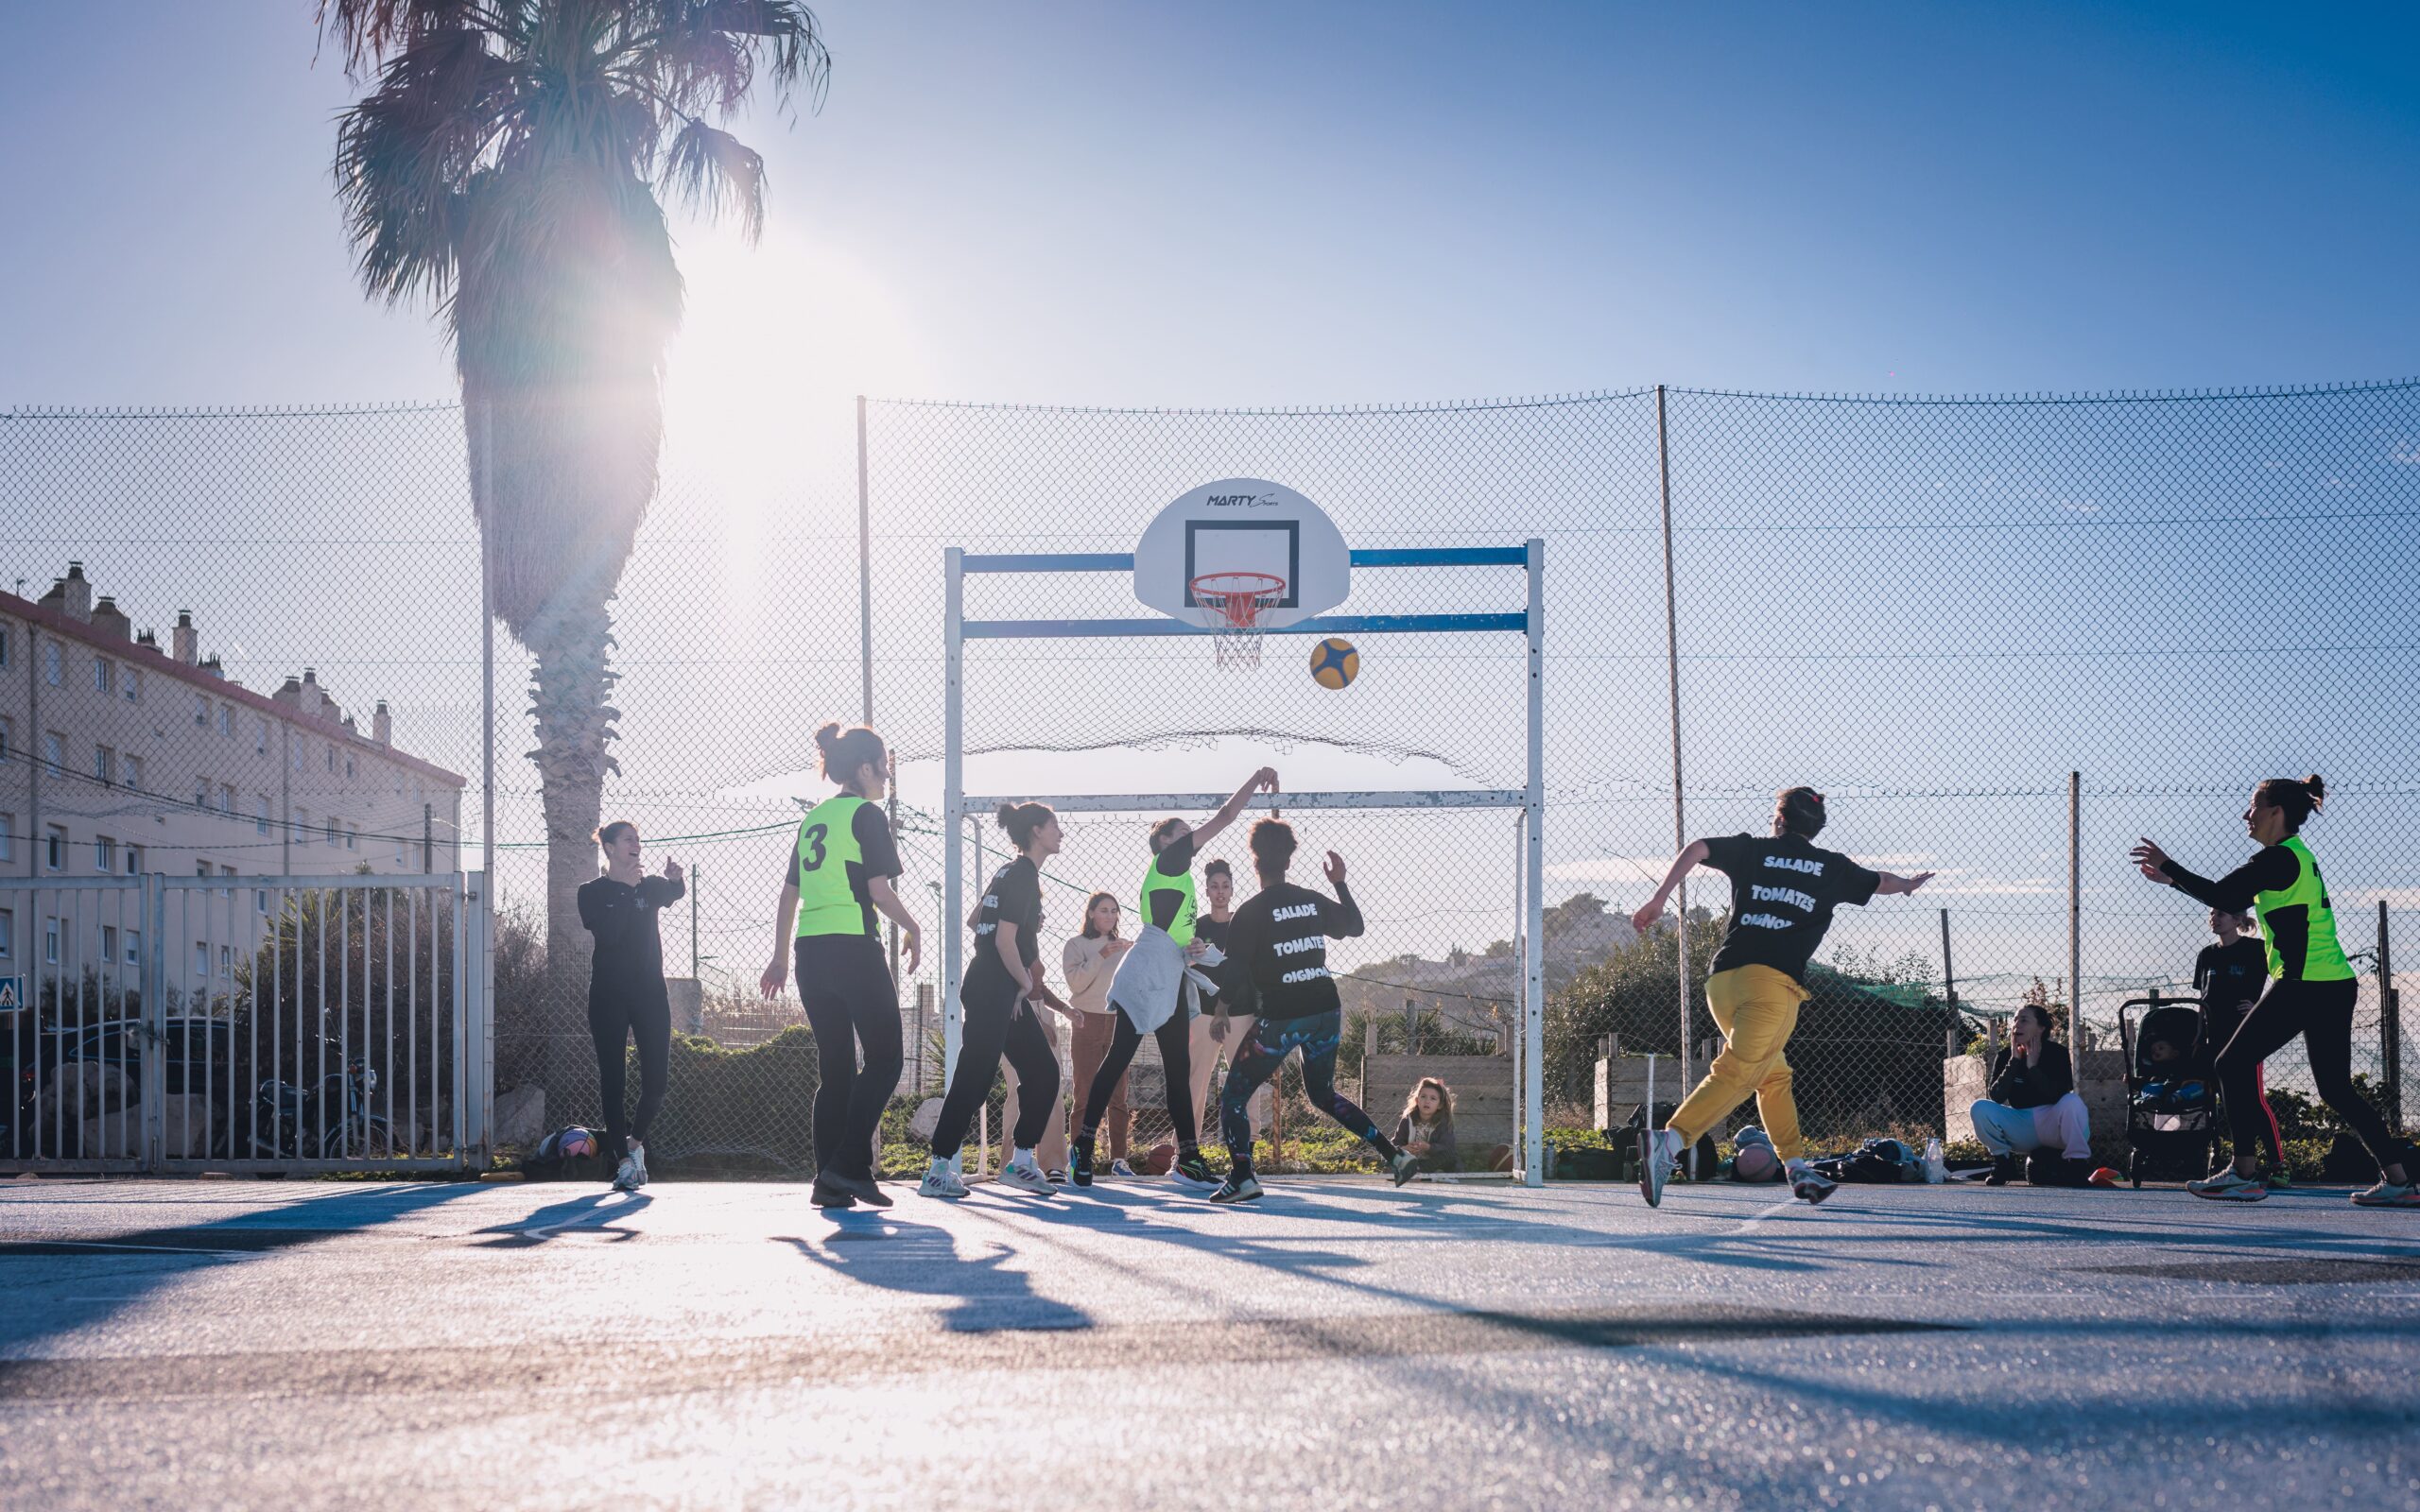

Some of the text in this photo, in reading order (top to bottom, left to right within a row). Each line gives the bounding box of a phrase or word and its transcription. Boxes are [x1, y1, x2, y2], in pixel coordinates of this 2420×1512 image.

[1206, 494, 1256, 507] MARTY
[802, 822, 828, 872] 3
[1764, 856, 1824, 877] SALADE
[1752, 885, 1816, 913] TOMATES
[1272, 903, 1318, 922] SALADE
[1273, 935, 1325, 957] TOMATE
[1282, 965, 1332, 984] OIGNON
